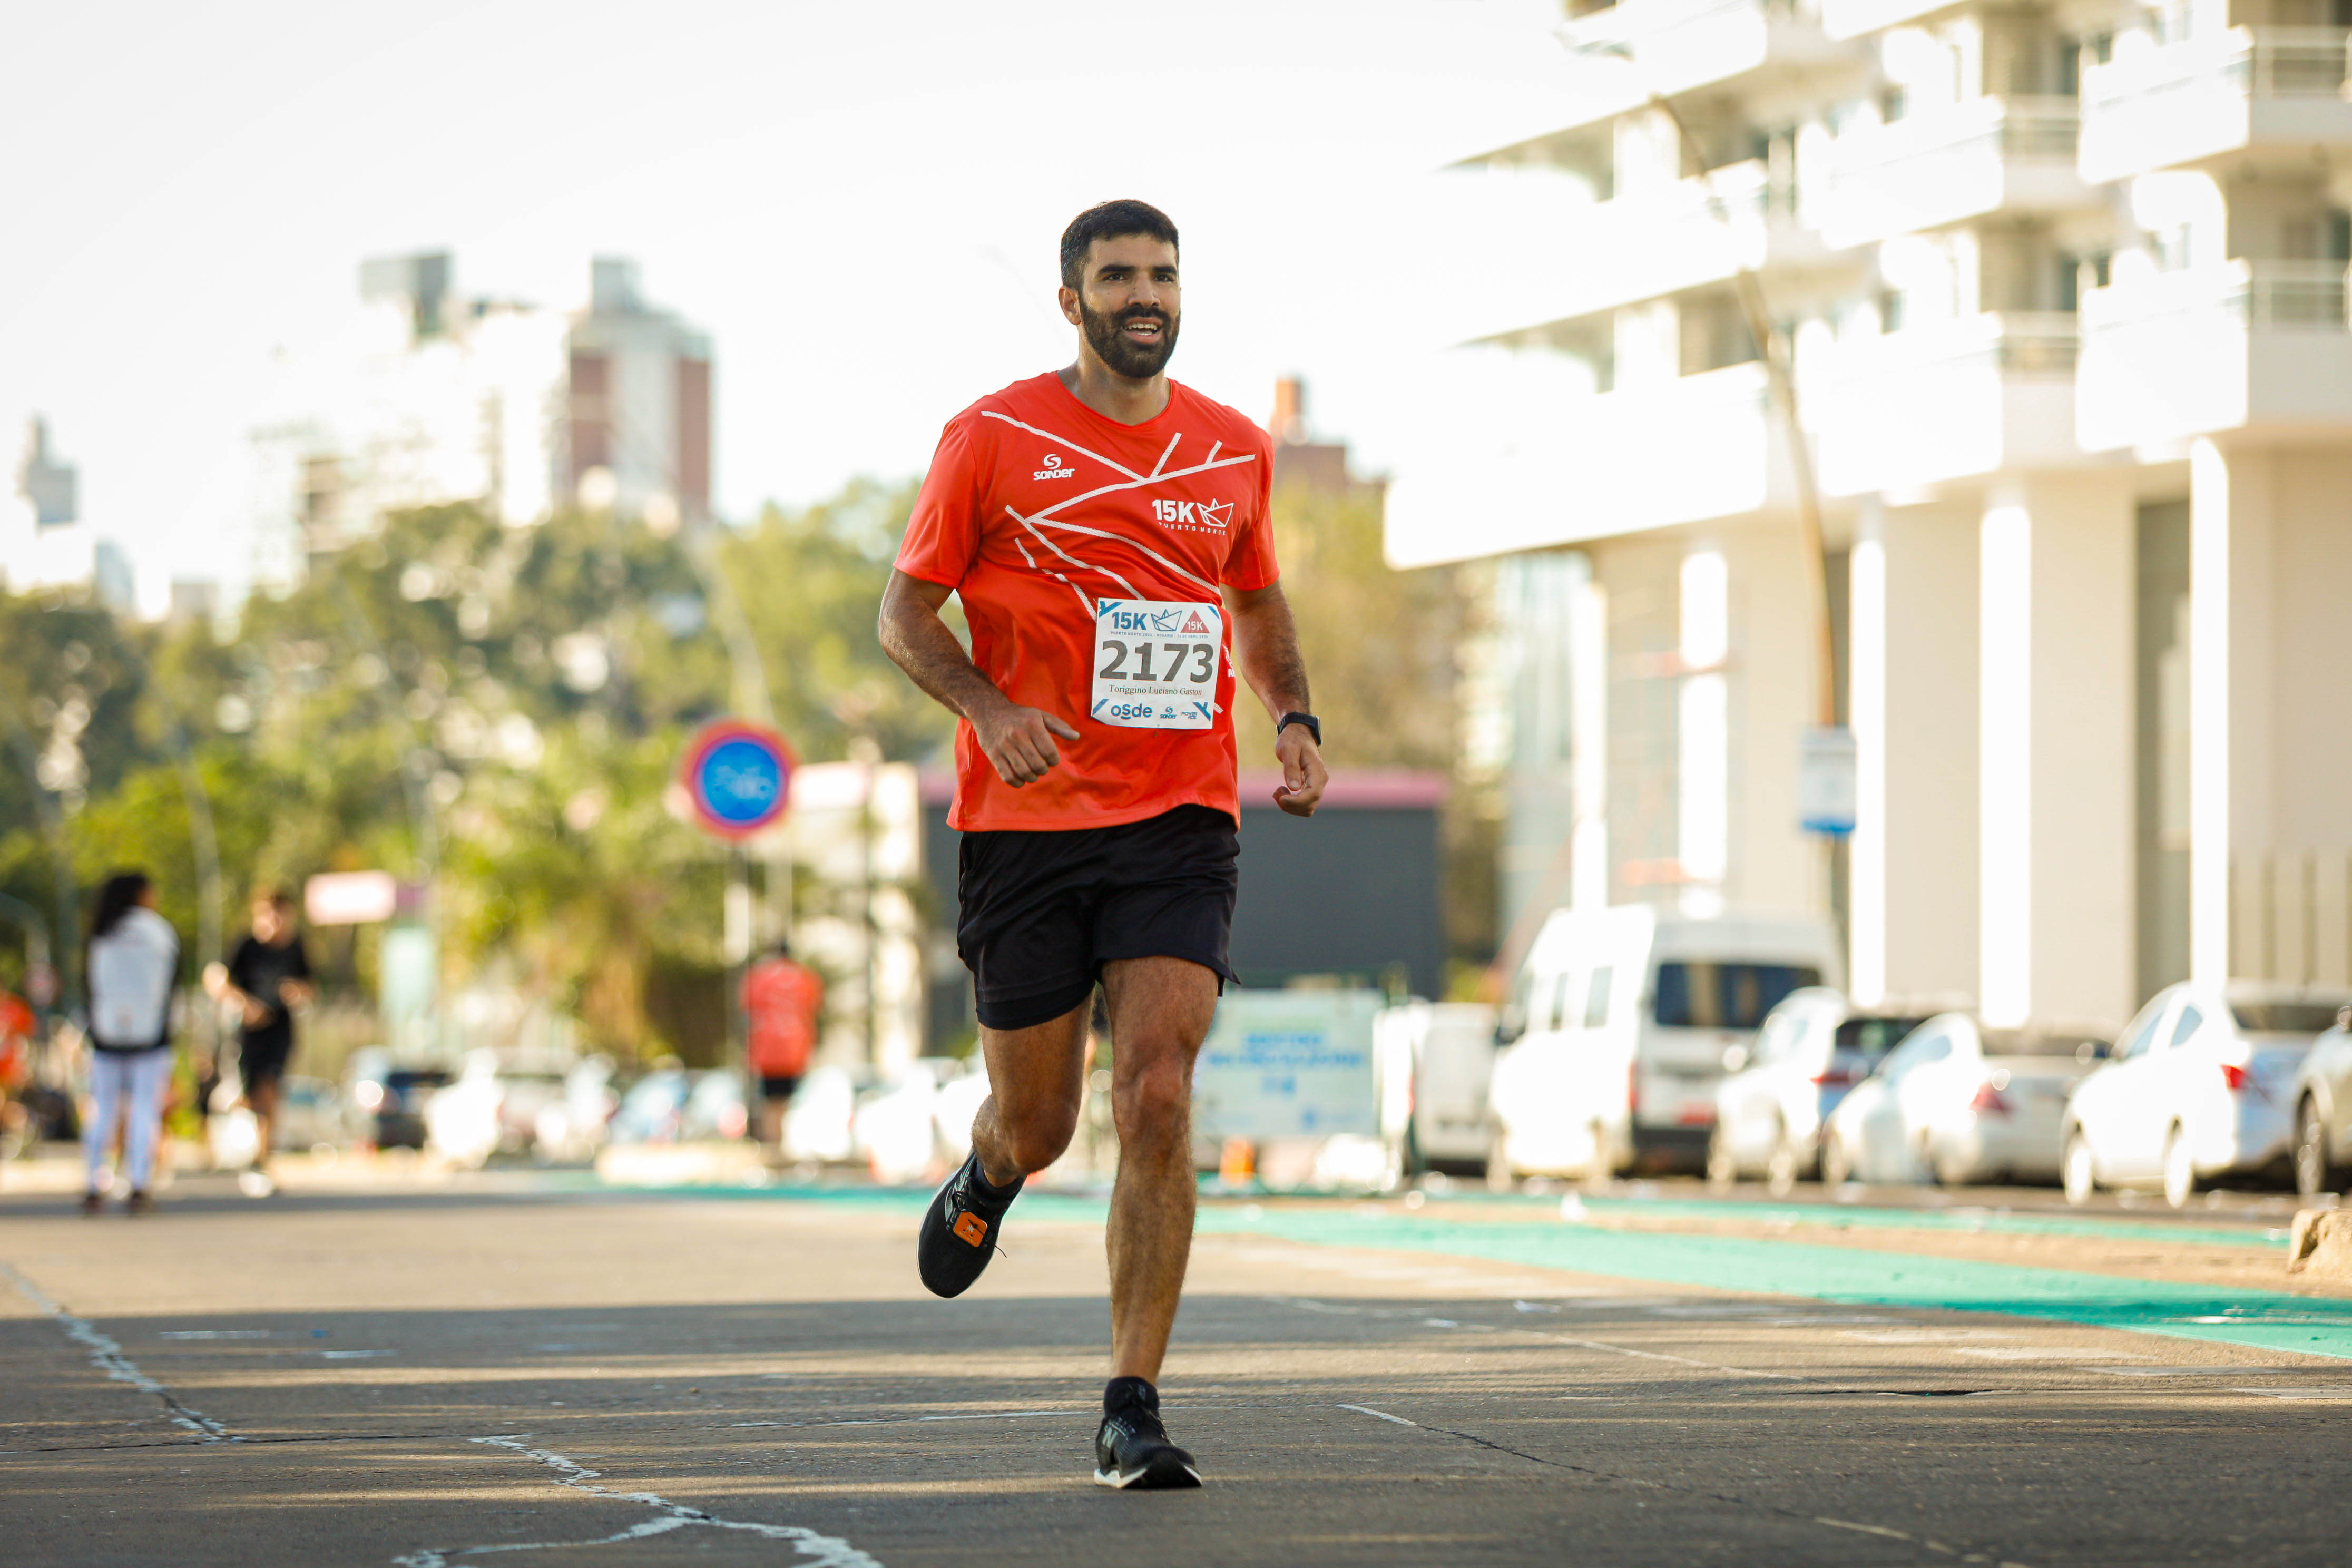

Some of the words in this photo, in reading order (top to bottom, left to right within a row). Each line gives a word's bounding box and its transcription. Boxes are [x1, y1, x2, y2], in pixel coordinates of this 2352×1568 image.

[1152, 499, 1196, 523] 15K
[1200, 527, 1226, 536] NORTE
[1112, 612, 1148, 630] 15K
[1187, 621, 1204, 631] 15K
[1100, 640, 1214, 683] 2173
[1109, 684, 1146, 695] Toriggino
[1149, 687, 1178, 695] Luciano
